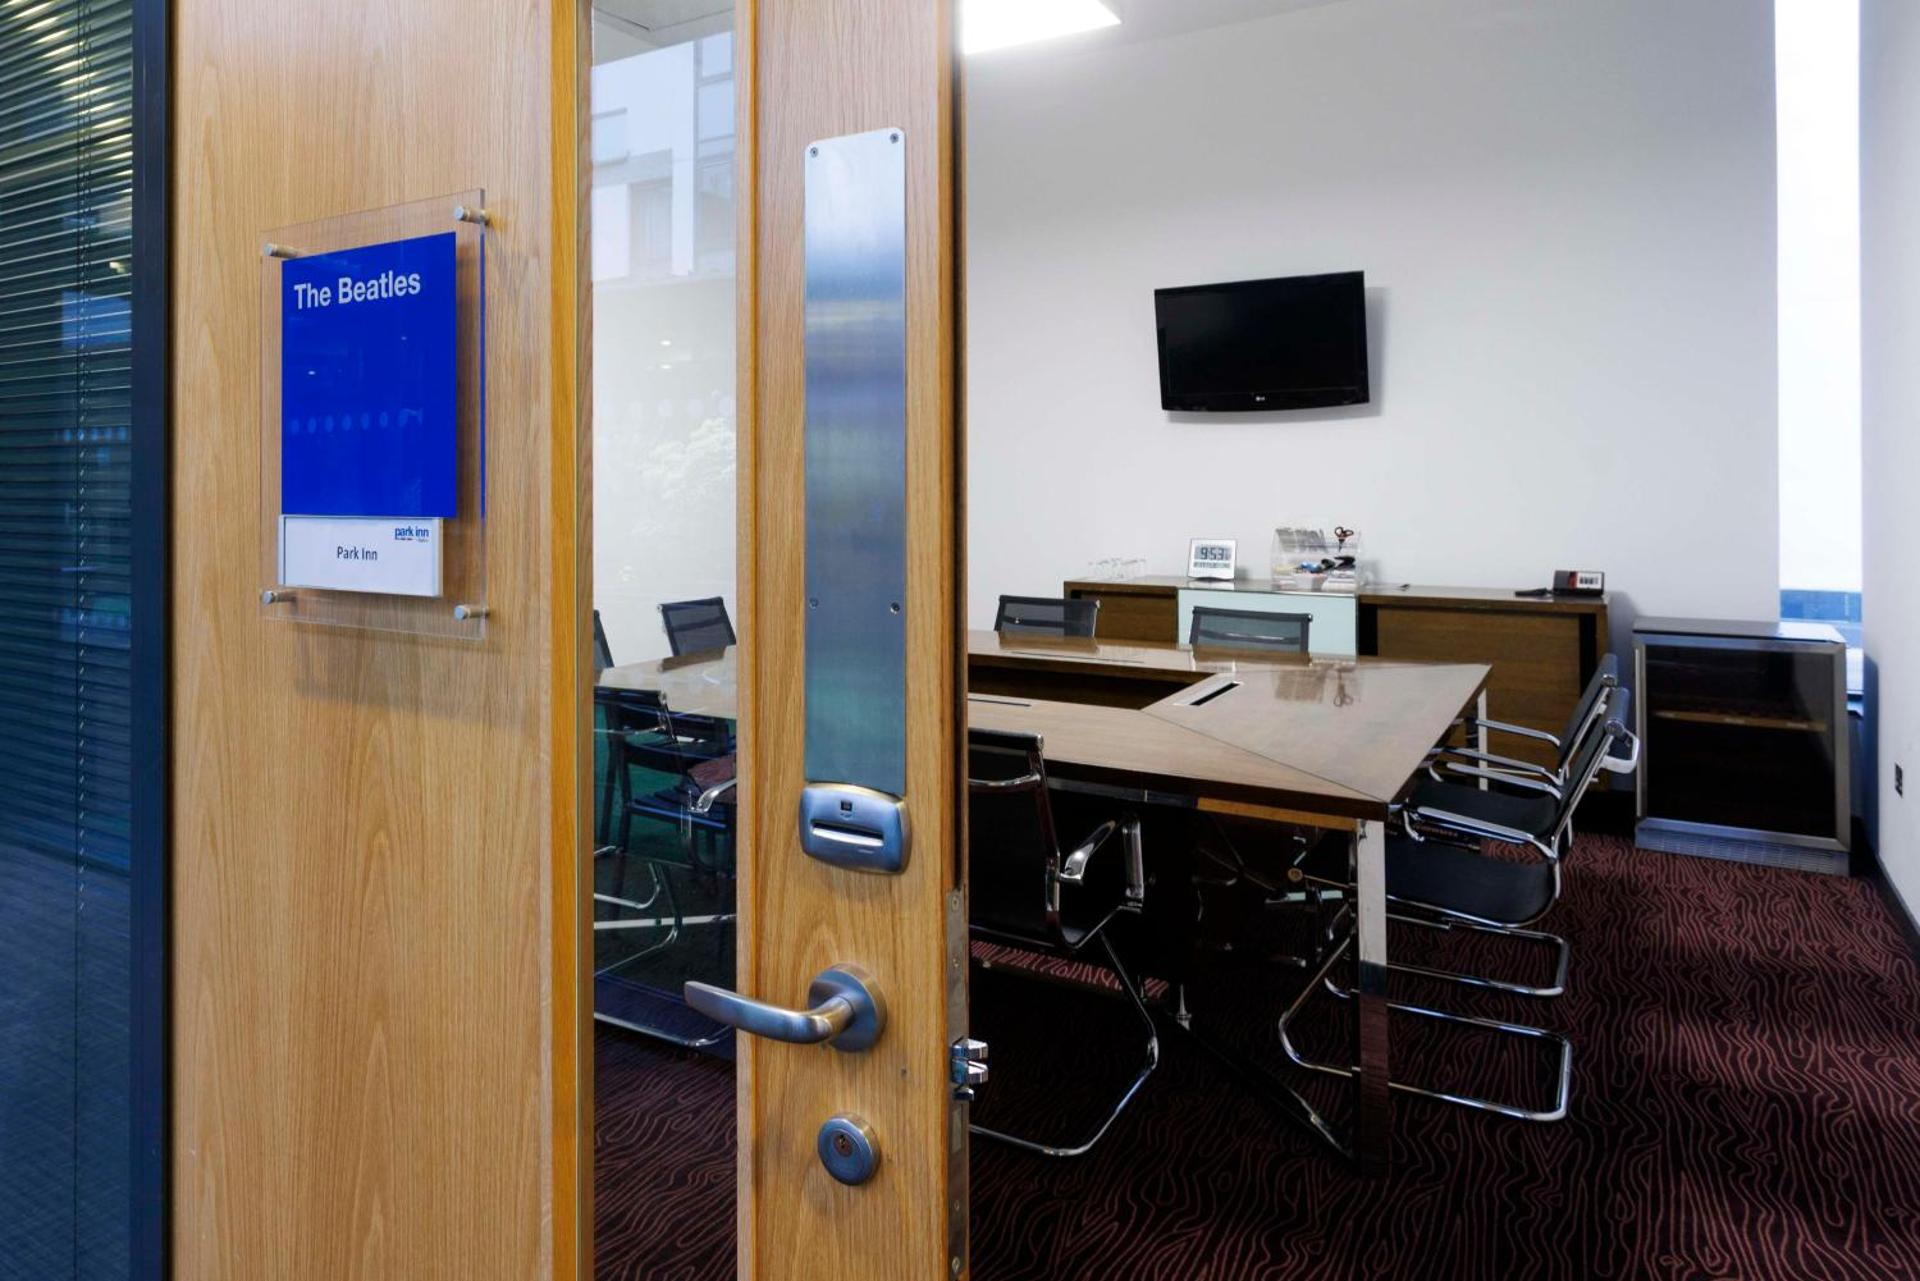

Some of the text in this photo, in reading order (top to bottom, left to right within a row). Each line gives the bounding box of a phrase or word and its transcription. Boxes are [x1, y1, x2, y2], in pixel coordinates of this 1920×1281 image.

[293, 270, 421, 310] The Beatles
[337, 546, 378, 561] Park Inn
